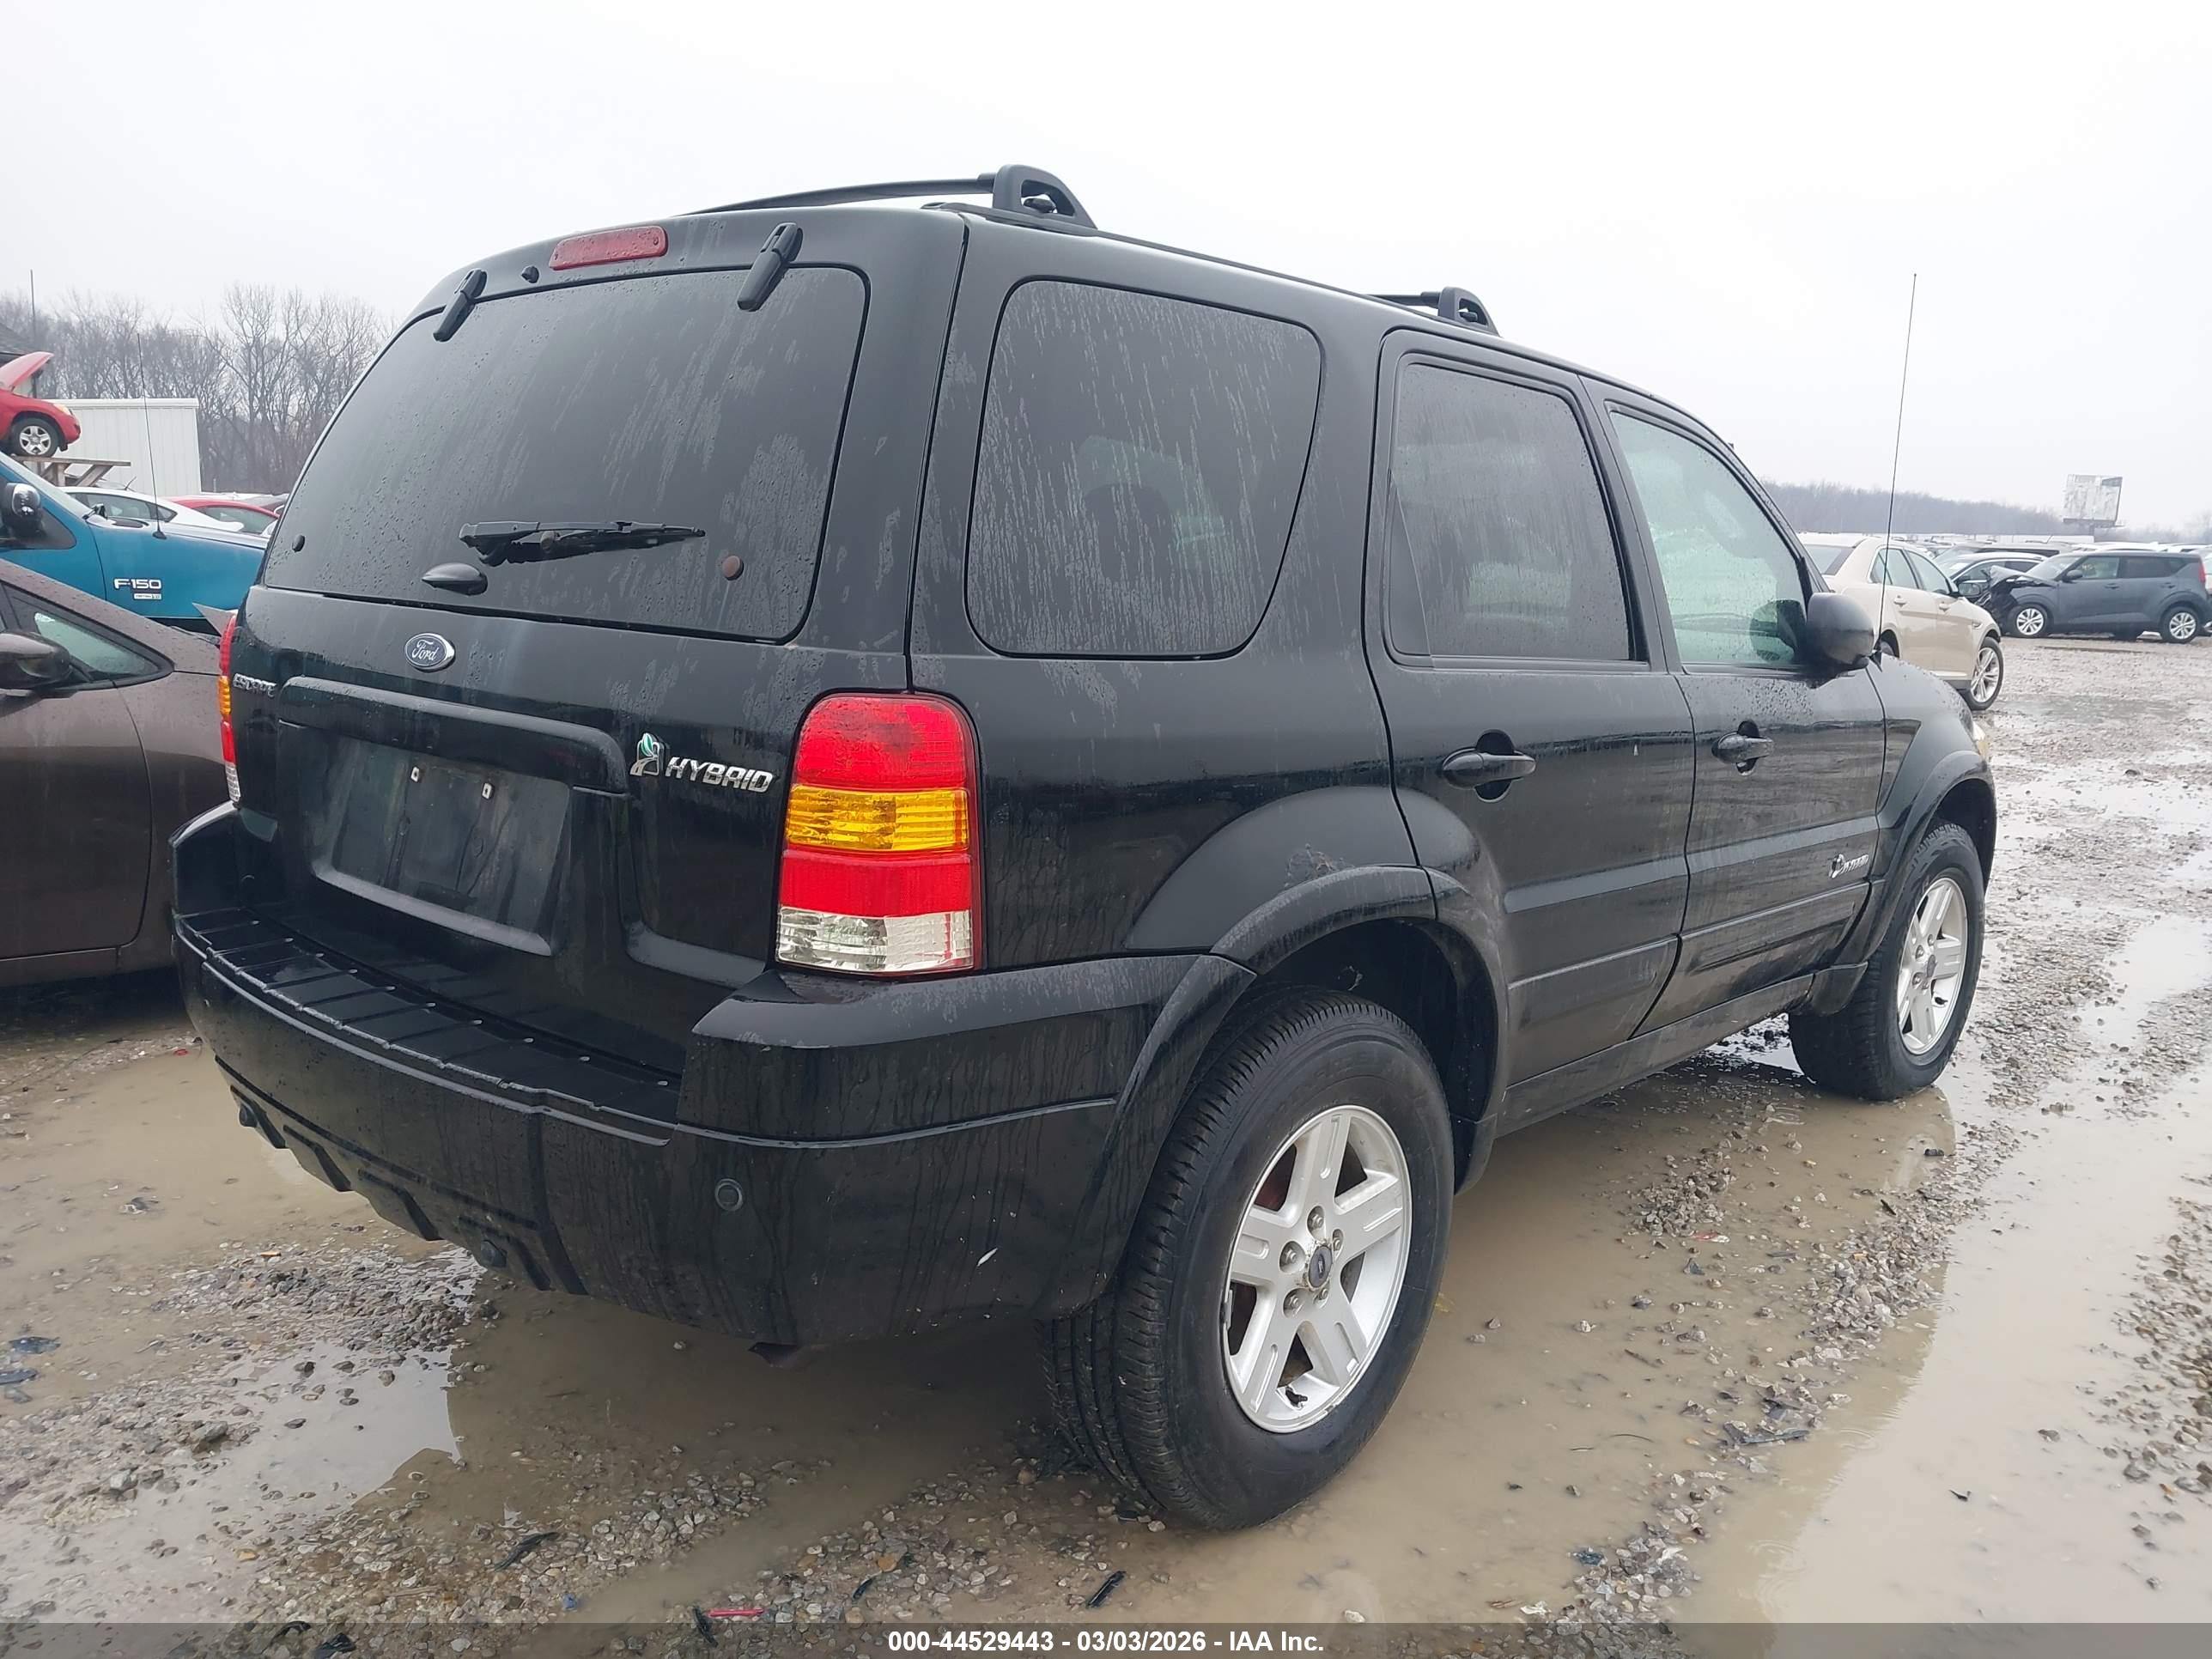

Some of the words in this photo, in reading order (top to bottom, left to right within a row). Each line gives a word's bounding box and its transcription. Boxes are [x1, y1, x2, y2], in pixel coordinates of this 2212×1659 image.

[114, 578, 161, 589] F-150
[411, 639, 440, 660] Ford
[665, 757, 774, 793] HYBRID
